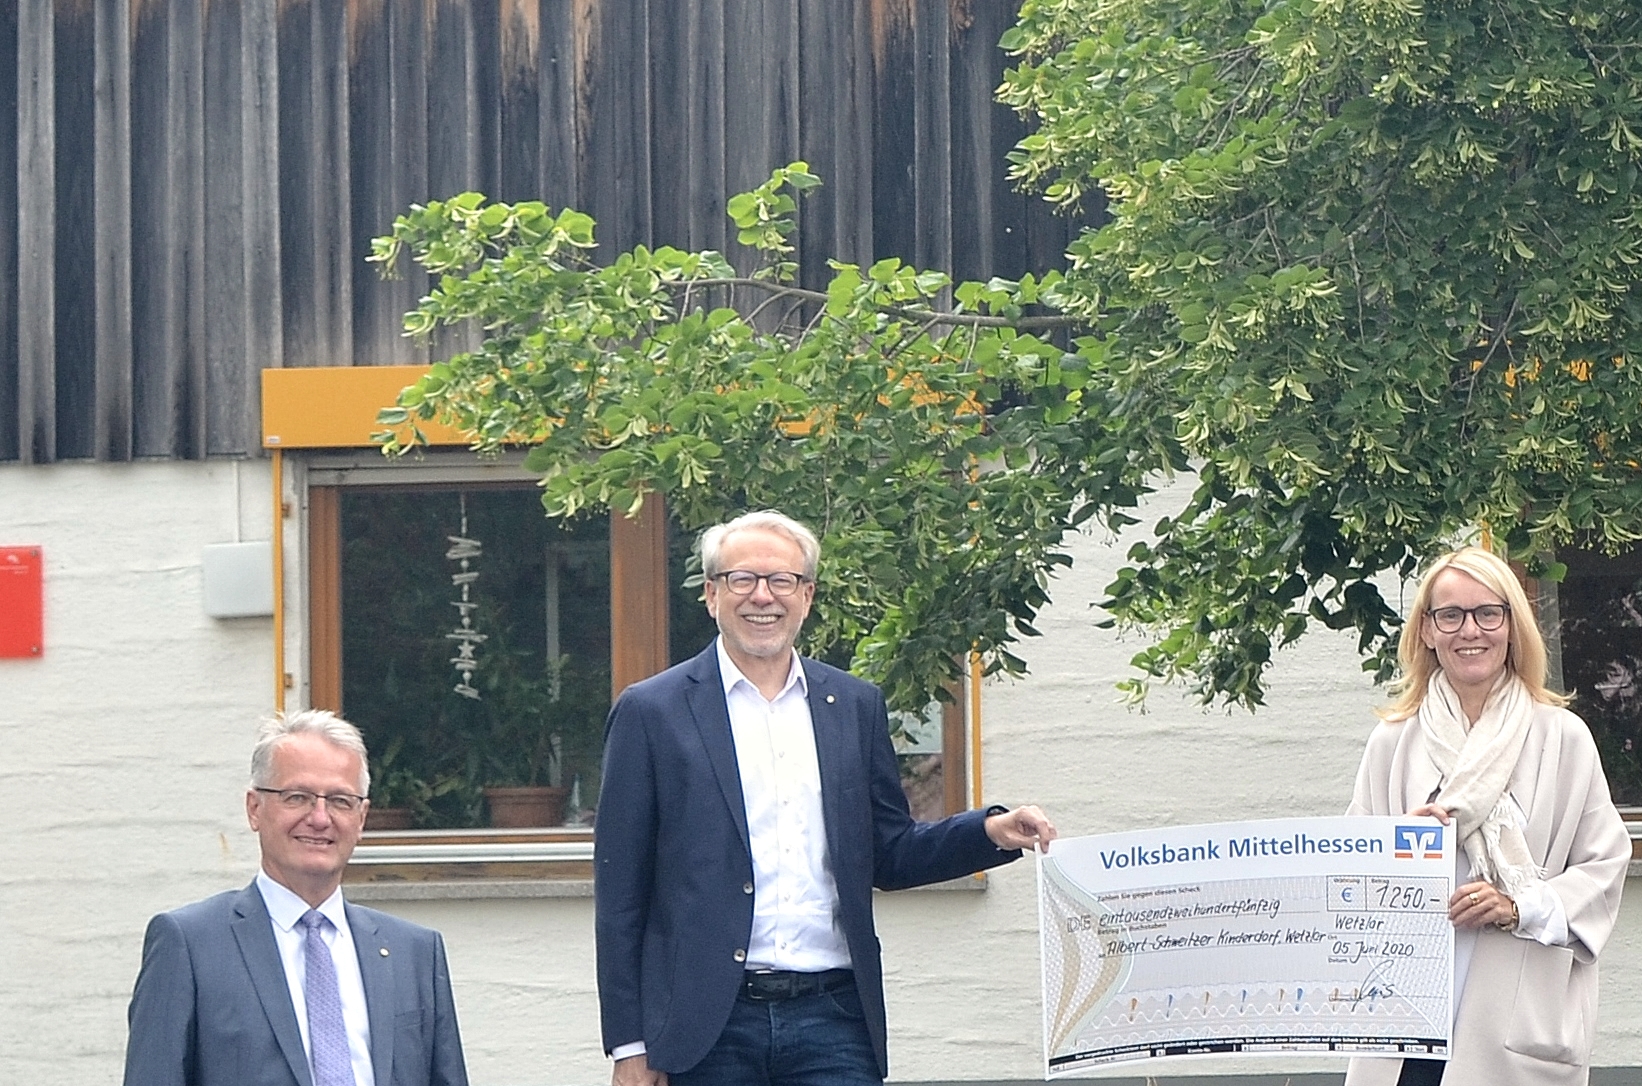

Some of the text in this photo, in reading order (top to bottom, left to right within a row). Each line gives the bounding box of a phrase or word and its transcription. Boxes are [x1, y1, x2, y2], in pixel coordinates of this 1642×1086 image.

[1100, 834, 1383, 869] Volksbank Mittelhessen
[1341, 887, 1353, 903] €
[1335, 914, 1384, 930] Wetzlar
[1382, 941, 1414, 956] 2020
